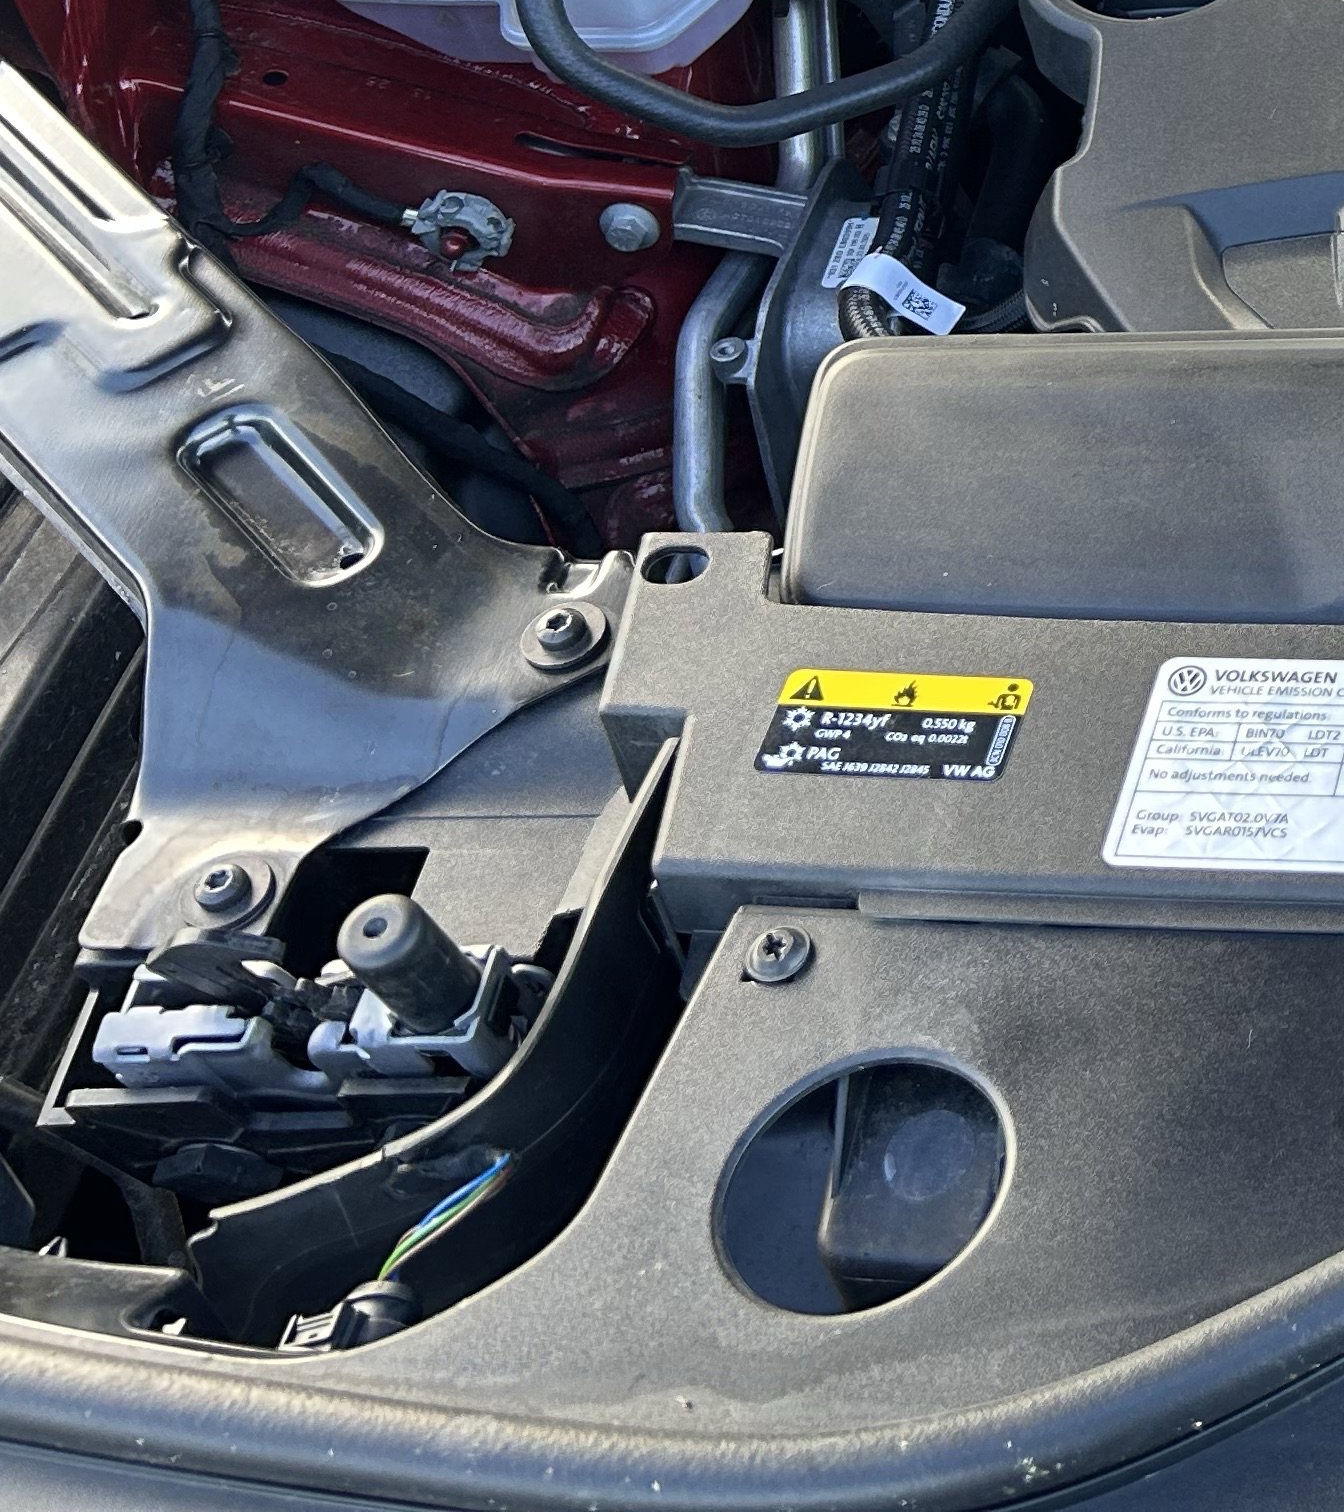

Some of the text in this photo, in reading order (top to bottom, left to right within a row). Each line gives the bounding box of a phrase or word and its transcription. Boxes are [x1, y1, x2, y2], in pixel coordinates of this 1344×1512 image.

[1215, 669, 1338, 683] VOLKSWAGEN
[1210, 685, 1264, 695] VEHICLE
[1268, 686, 1333, 696] EMISSION
[1168, 707, 1248, 718] Conforms to
[820, 712, 976, 733] R-1234yf 0.550 kg
[815, 729, 841, 738] GWP
[842, 730, 851, 739] 4
[911, 736, 926, 745] eq
[1162, 726, 1187, 737] U.S.
[1246, 728, 1341, 740] BIN70 LDT2
[806, 747, 841, 760] PAG
[1304, 748, 1329, 758] LDT
[821, 762, 842, 771] SAE
[942, 765, 995, 778] VW AG
[1149, 769, 1311, 783] No adjustments needed.
[1132, 824, 1167, 837] Evap:
